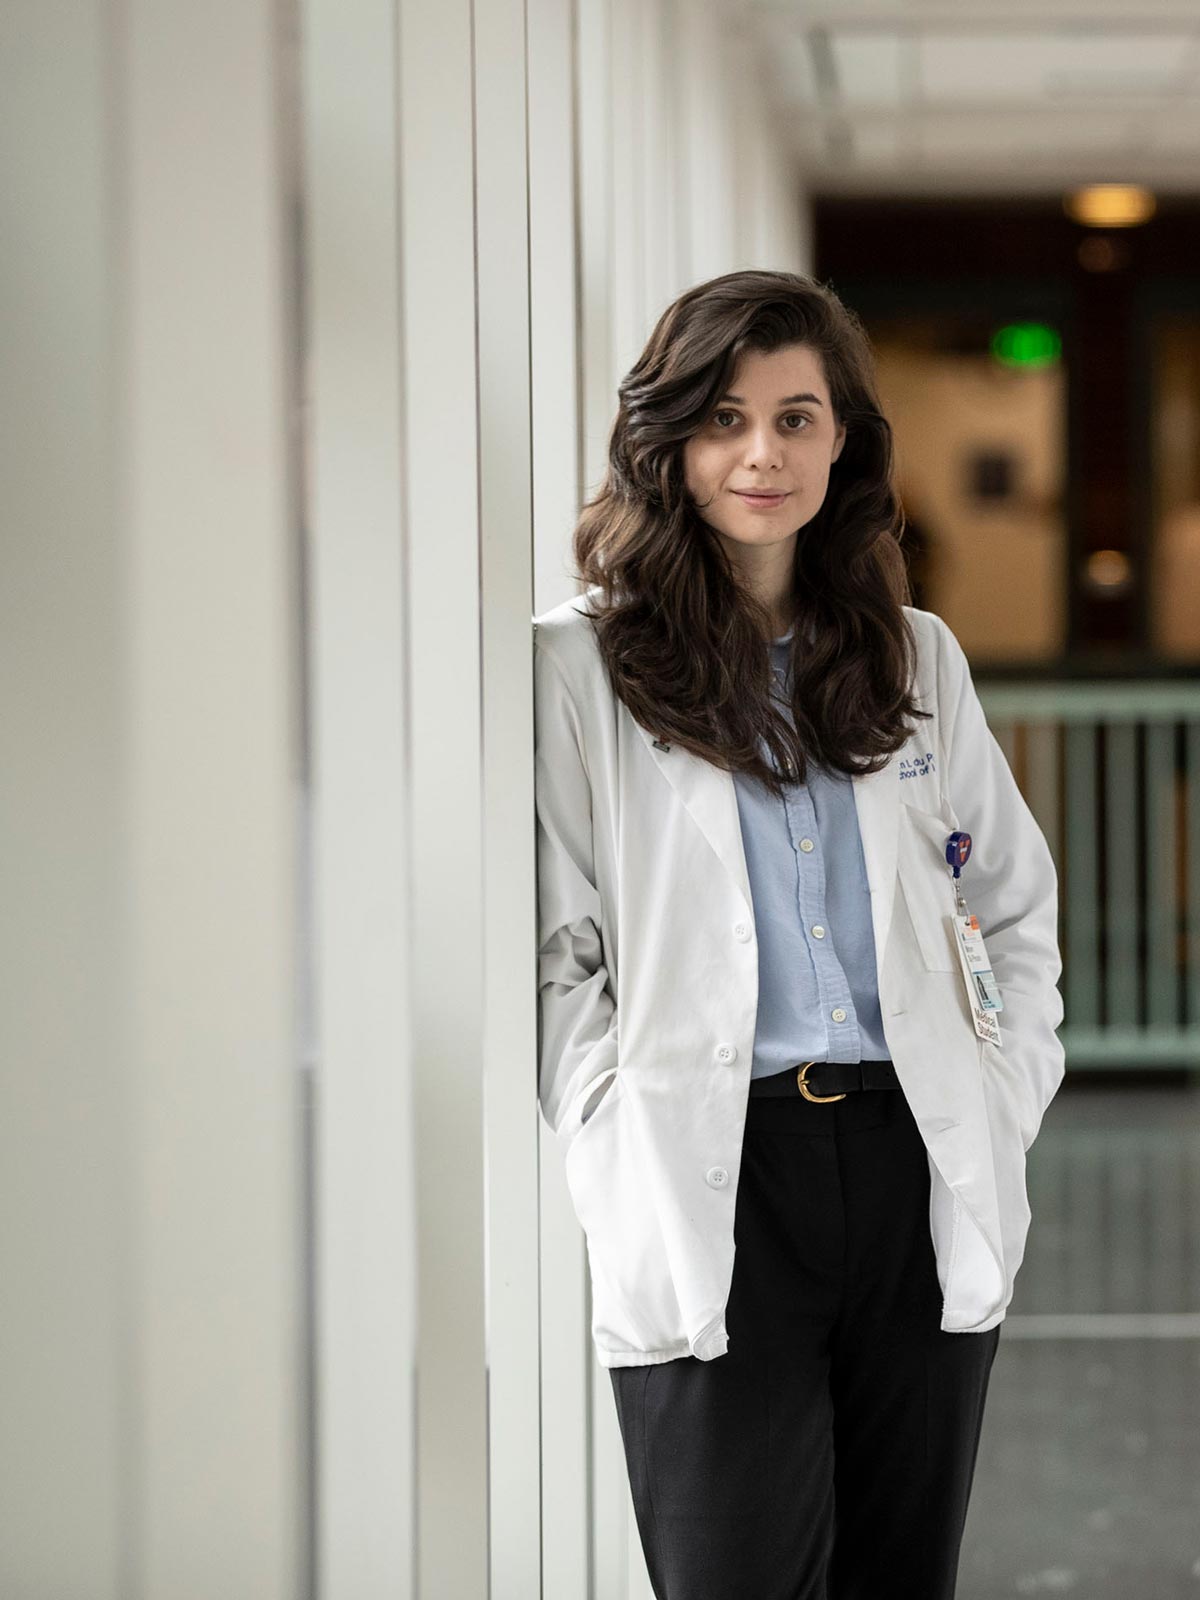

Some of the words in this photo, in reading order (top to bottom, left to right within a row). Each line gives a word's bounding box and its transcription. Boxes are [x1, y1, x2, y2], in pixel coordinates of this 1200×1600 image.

[926, 753, 933, 763] P
[899, 769, 917, 779] chool
[919, 764, 929, 776] of
[974, 1008, 996, 1028] Medical
[977, 1021, 1000, 1041] Student
